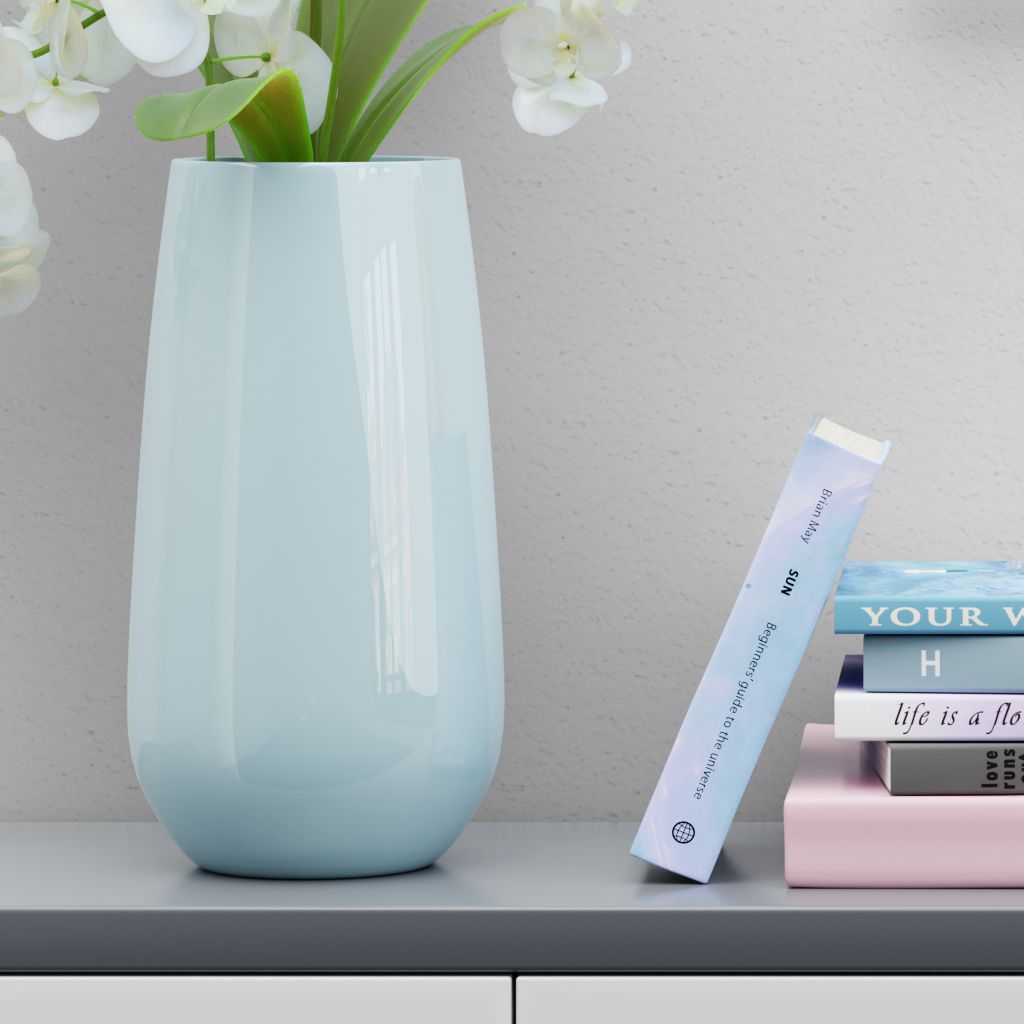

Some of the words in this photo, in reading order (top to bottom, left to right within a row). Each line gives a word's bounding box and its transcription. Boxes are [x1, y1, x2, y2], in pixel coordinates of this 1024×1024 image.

[813, 488, 833, 518] Brian
[800, 519, 820, 544] May
[780, 568, 799, 596] SUN
[861, 606, 989, 627] YOUR
[729, 680, 749, 714] guide
[723, 716, 735, 728] to
[894, 702, 930, 735] life
[940, 706, 959, 726] is
[968, 710, 988, 726] a
[713, 731, 729, 750] the
[693, 752, 719, 800] universe
[981, 750, 998, 788] love
[1003, 748, 1016, 790] runs
